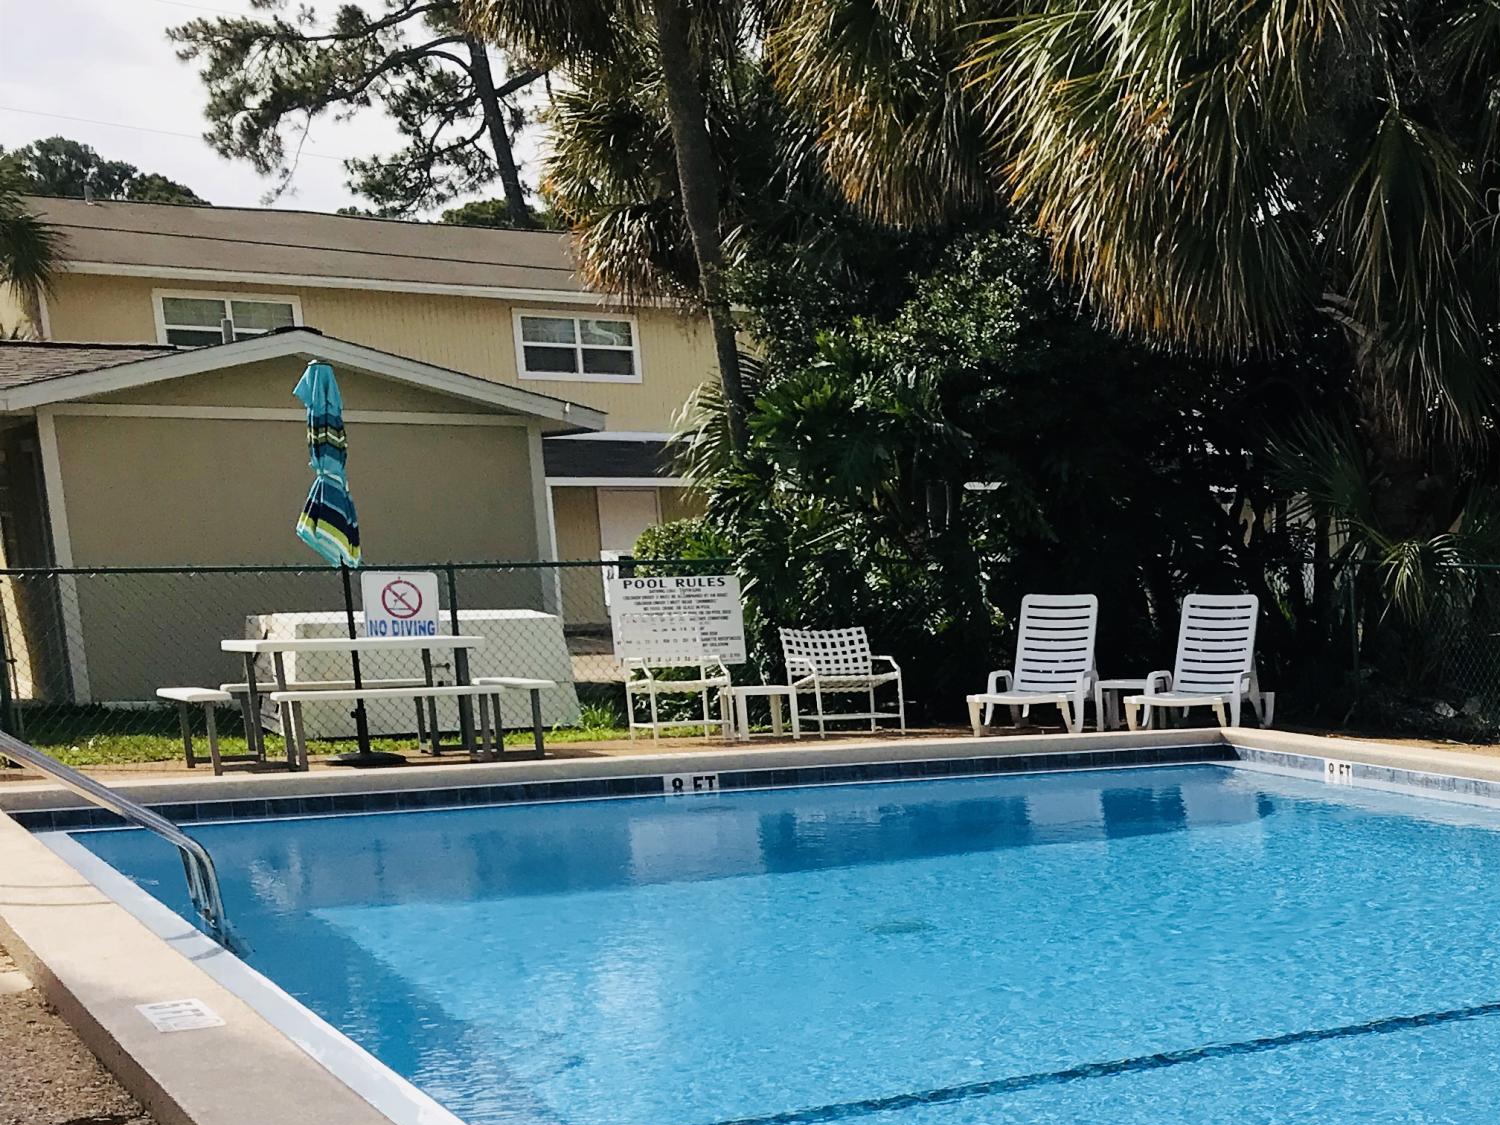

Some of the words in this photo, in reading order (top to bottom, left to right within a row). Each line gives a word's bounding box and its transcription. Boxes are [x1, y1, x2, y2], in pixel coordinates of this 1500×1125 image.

[623, 579, 668, 589] POOL
[675, 577, 726, 587] RULES
[369, 620, 388, 636] NO
[391, 620, 435, 636] DIVING
[693, 776, 716, 791] FT
